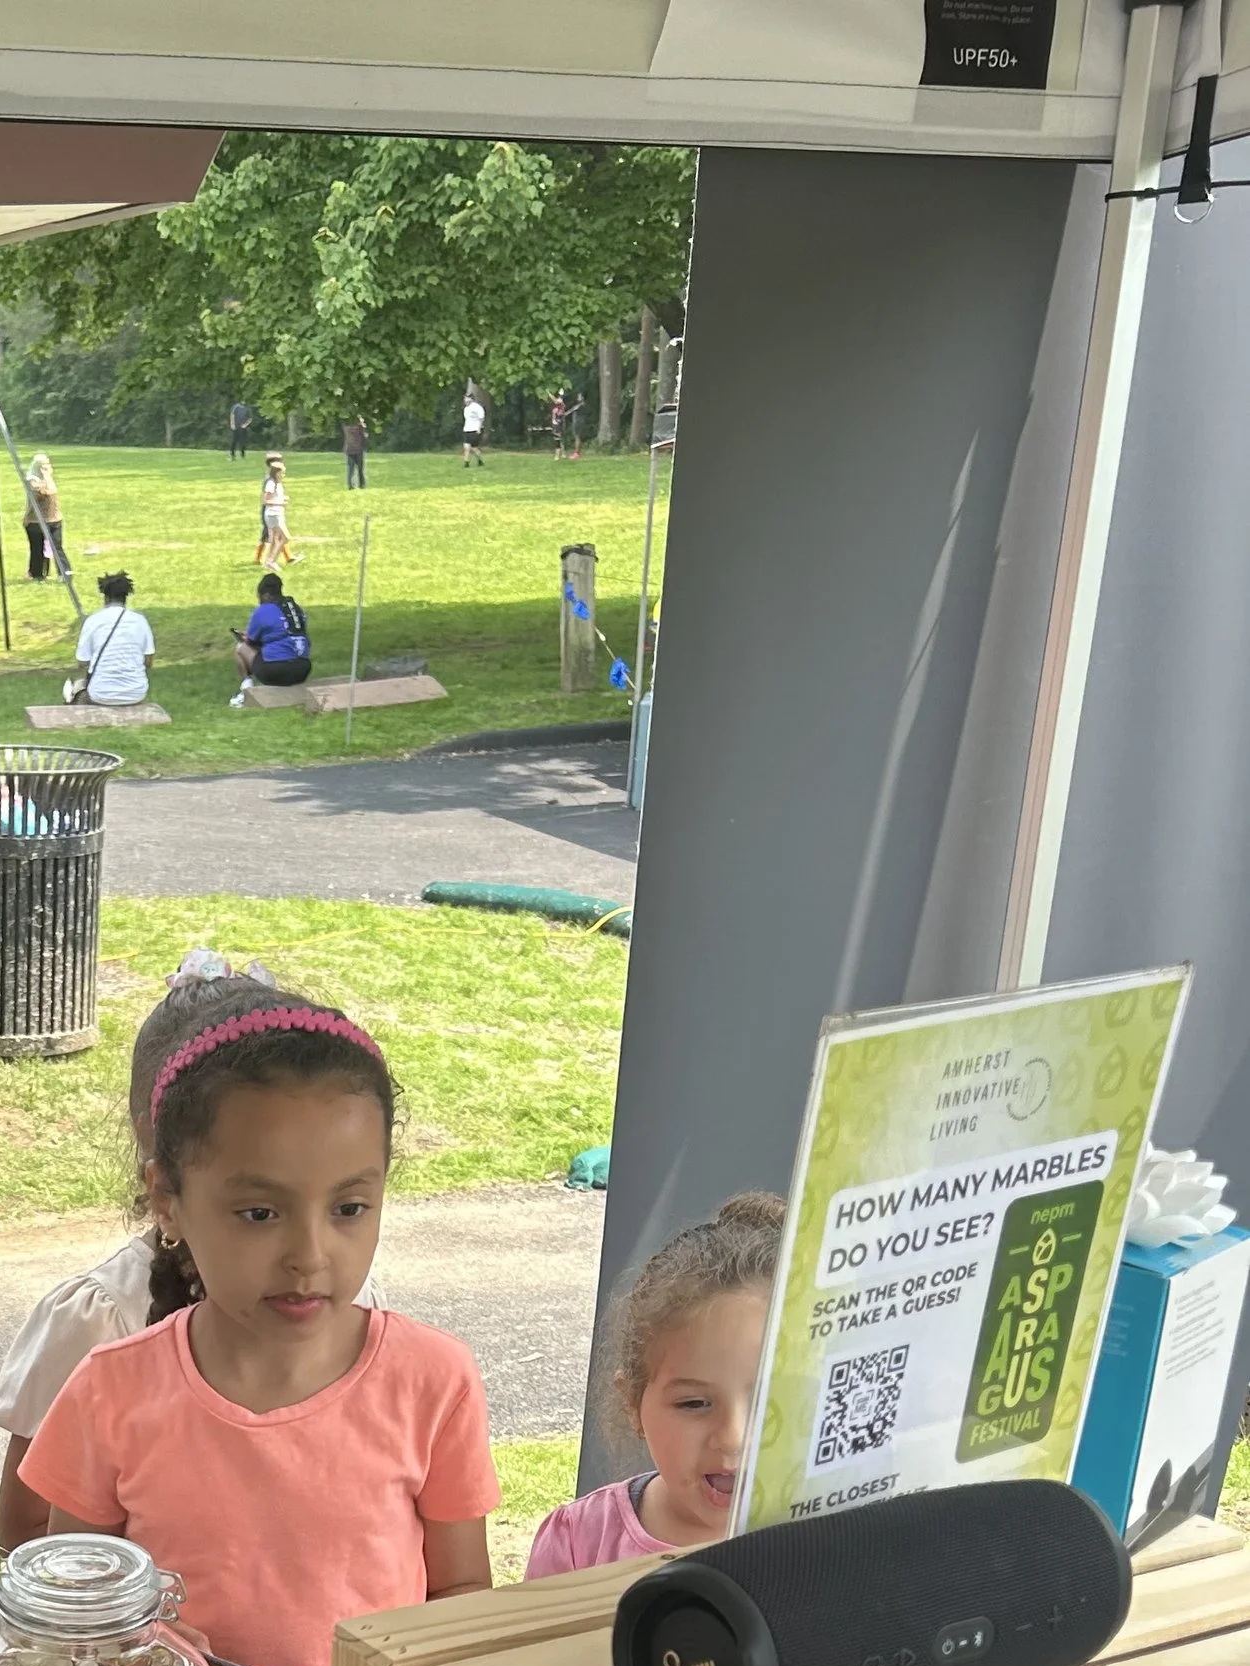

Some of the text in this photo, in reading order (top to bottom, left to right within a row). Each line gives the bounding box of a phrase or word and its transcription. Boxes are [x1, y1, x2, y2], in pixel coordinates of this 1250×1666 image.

[953, 47, 1018, 68] UPF50+
[942, 1049, 1011, 1080] AMHERST
[935, 1077, 1022, 1111] INNOVATIVE
[930, 1115, 979, 1141] LIVING
[835, 1144, 1108, 1229] HOW MANY MARBLES
[1030, 1202, 1076, 1226] nepm
[827, 1212, 995, 1274] DO YOU SEE?
[812, 1262, 979, 1318] SCAN THE QR CODE
[809, 1286, 963, 1340] TO TAKE A GUESS!
[969, 1407, 1041, 1447] FESTIVAL
[789, 1502, 822, 1519] THE
[826, 1473, 901, 1508] CLOSEST
